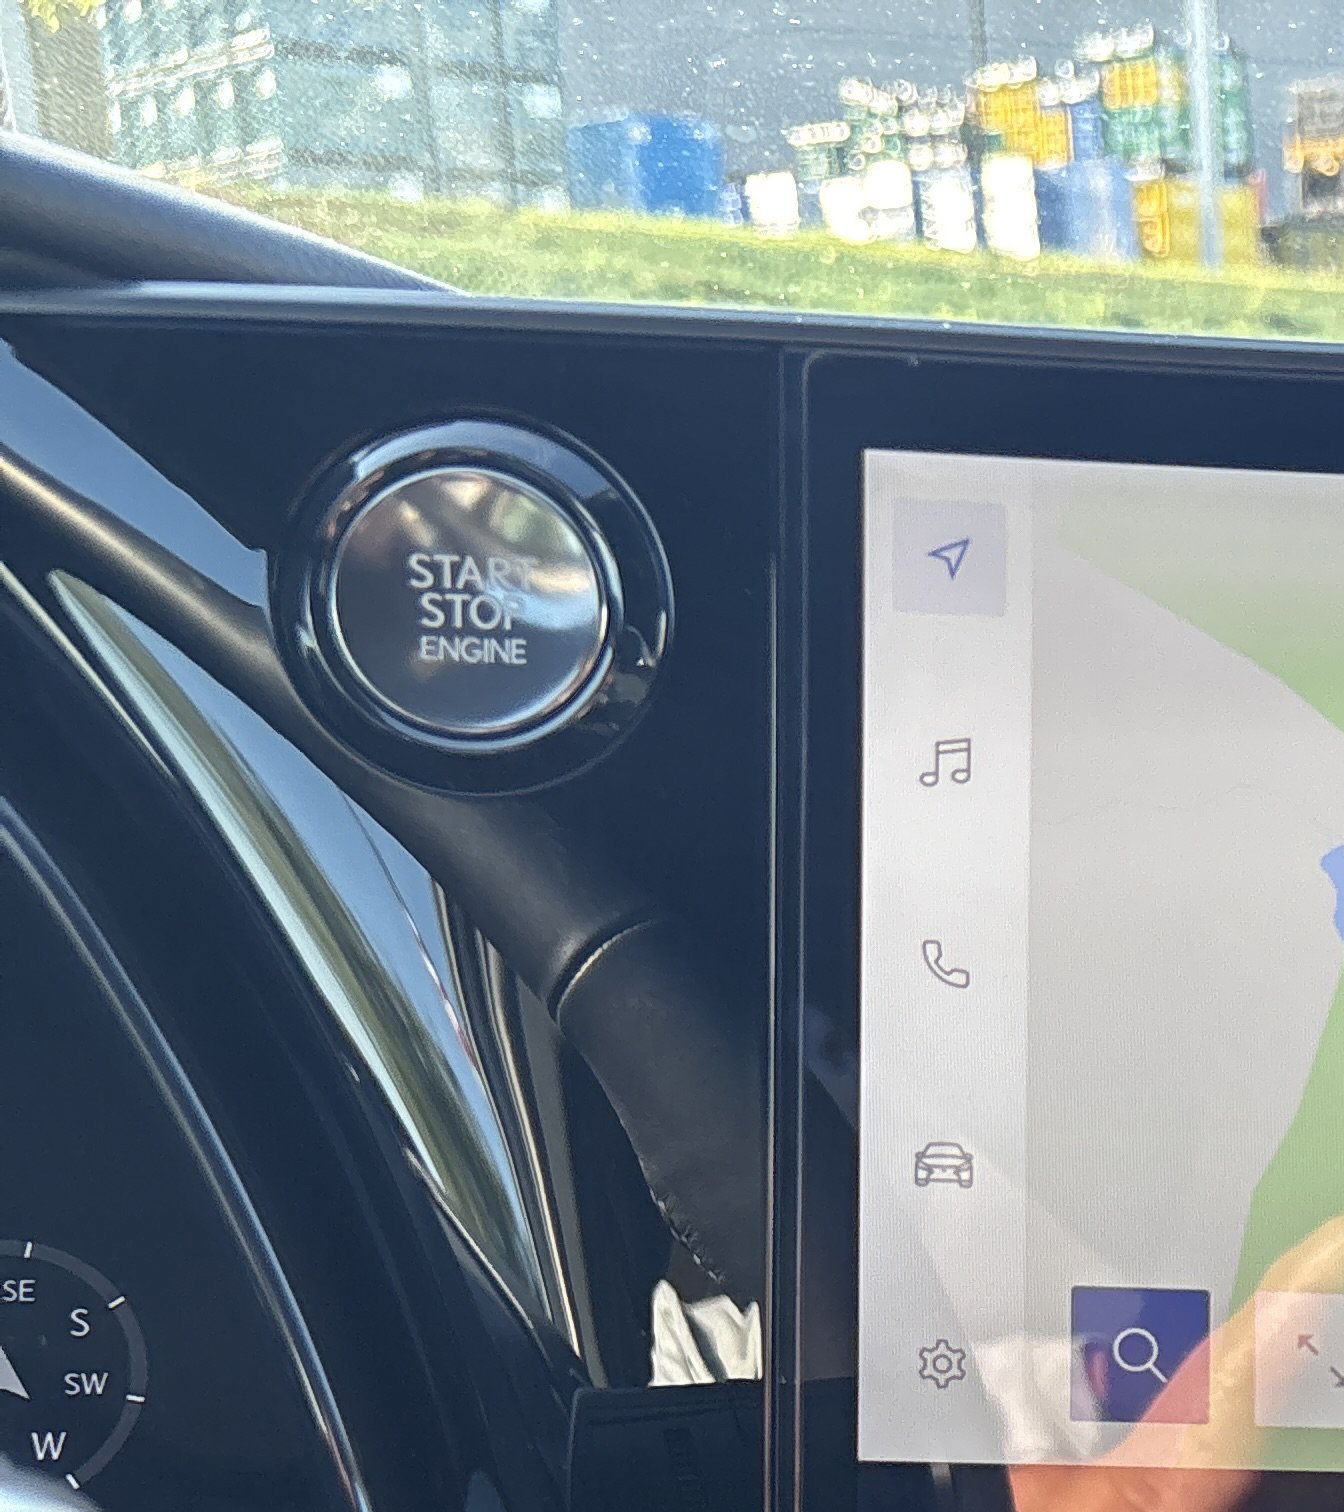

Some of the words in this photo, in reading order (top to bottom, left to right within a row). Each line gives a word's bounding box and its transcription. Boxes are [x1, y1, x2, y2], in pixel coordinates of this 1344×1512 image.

[408, 553, 539, 590] START
[420, 593, 525, 631] STOP
[420, 636, 527, 664] ENGINE
[2, 1279, 36, 1303] SE
[69, 1307, 91, 1338] S
[63, 1371, 109, 1396] SW
[31, 1430, 67, 1461] W
